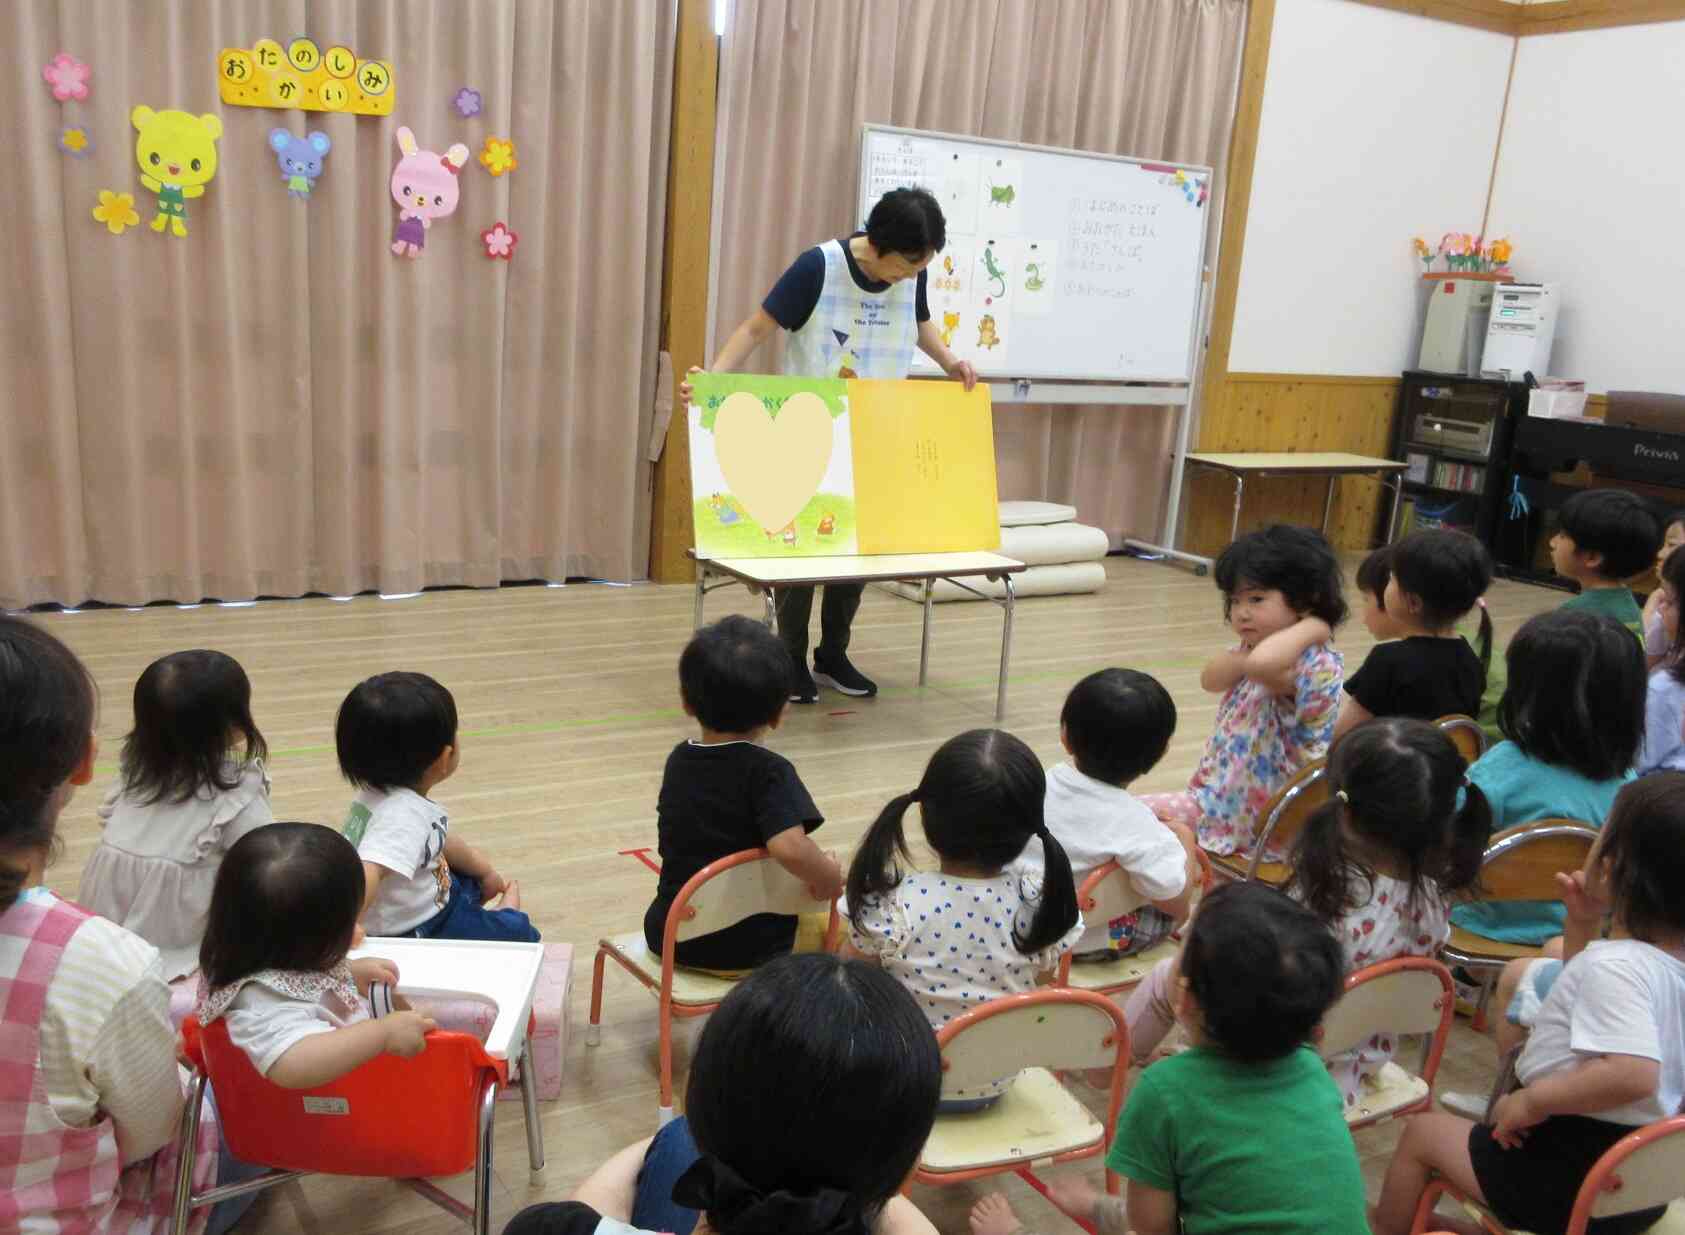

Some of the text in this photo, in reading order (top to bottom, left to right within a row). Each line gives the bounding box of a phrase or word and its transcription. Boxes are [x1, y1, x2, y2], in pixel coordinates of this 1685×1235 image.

[226, 47, 382, 88] おたのしみ
[279, 82, 343, 101] かい
